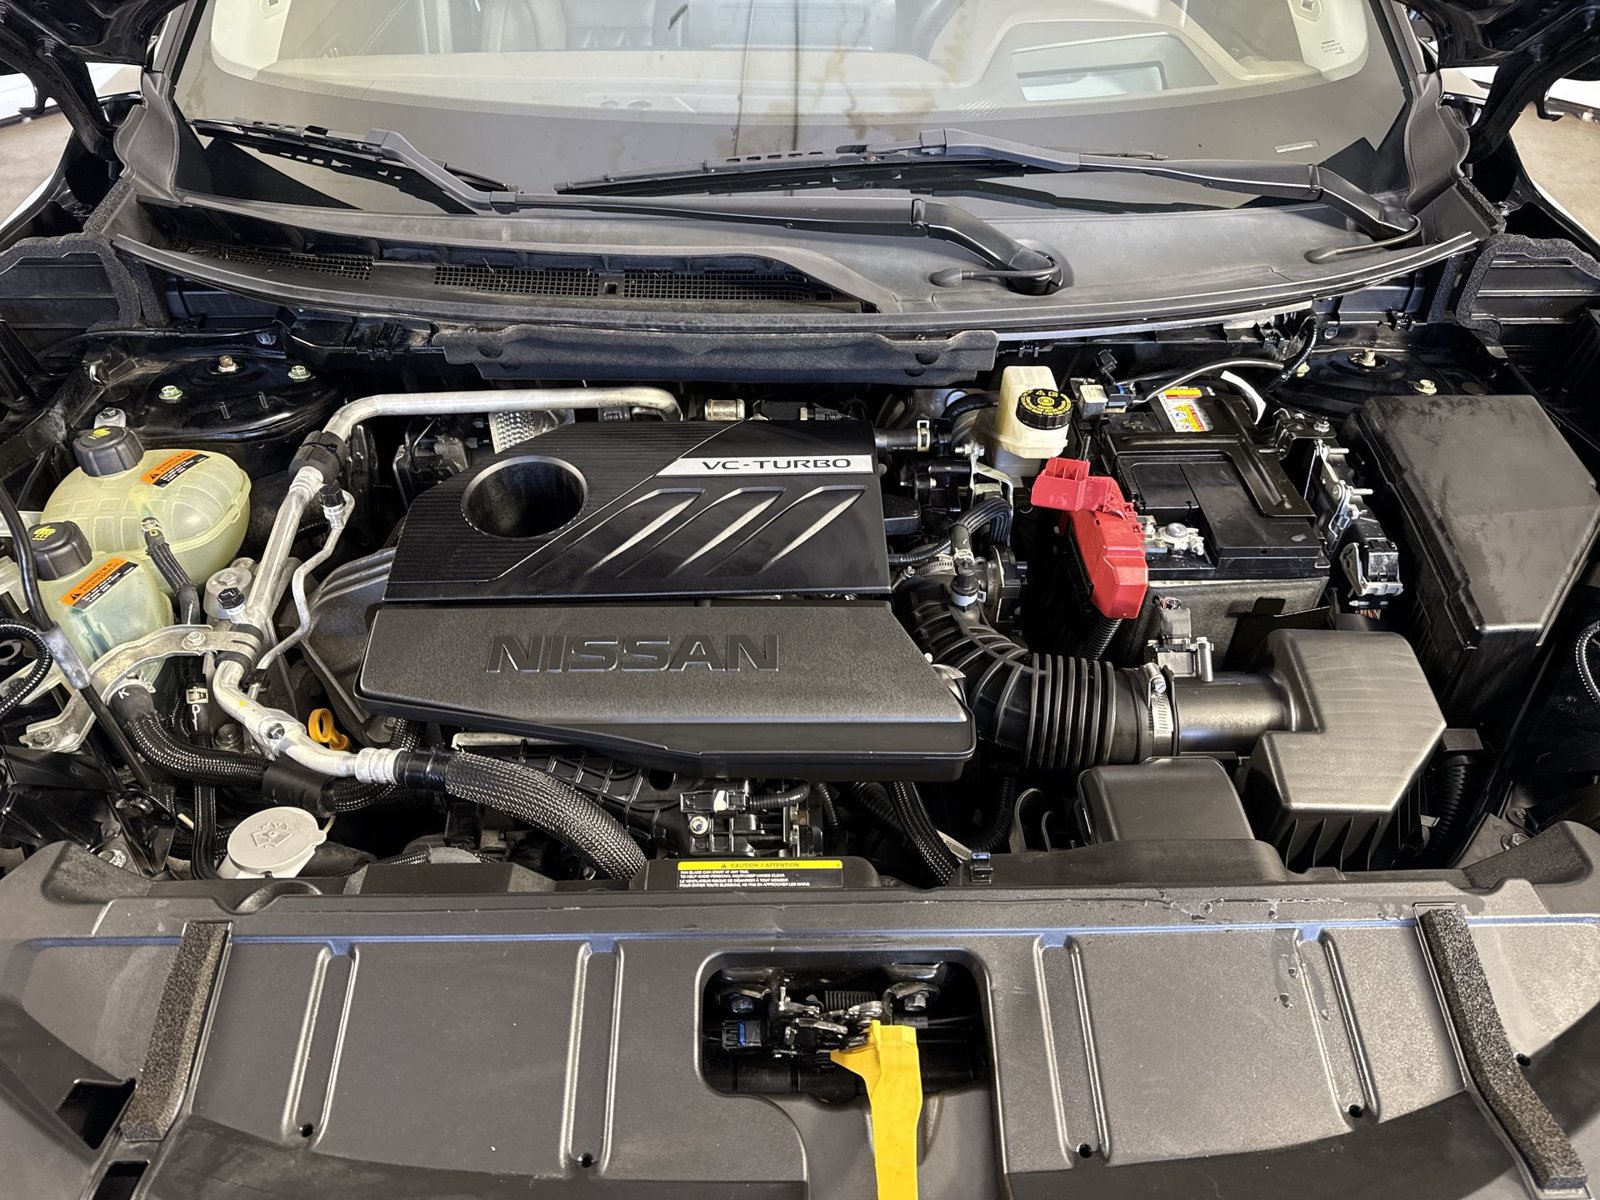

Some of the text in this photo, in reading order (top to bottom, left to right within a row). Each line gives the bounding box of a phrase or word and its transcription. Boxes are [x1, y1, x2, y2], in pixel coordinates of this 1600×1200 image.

[702, 458, 852, 470] VC-TURBO
[486, 634, 780, 673] NISSAN
[118, 687, 130, 699] K
